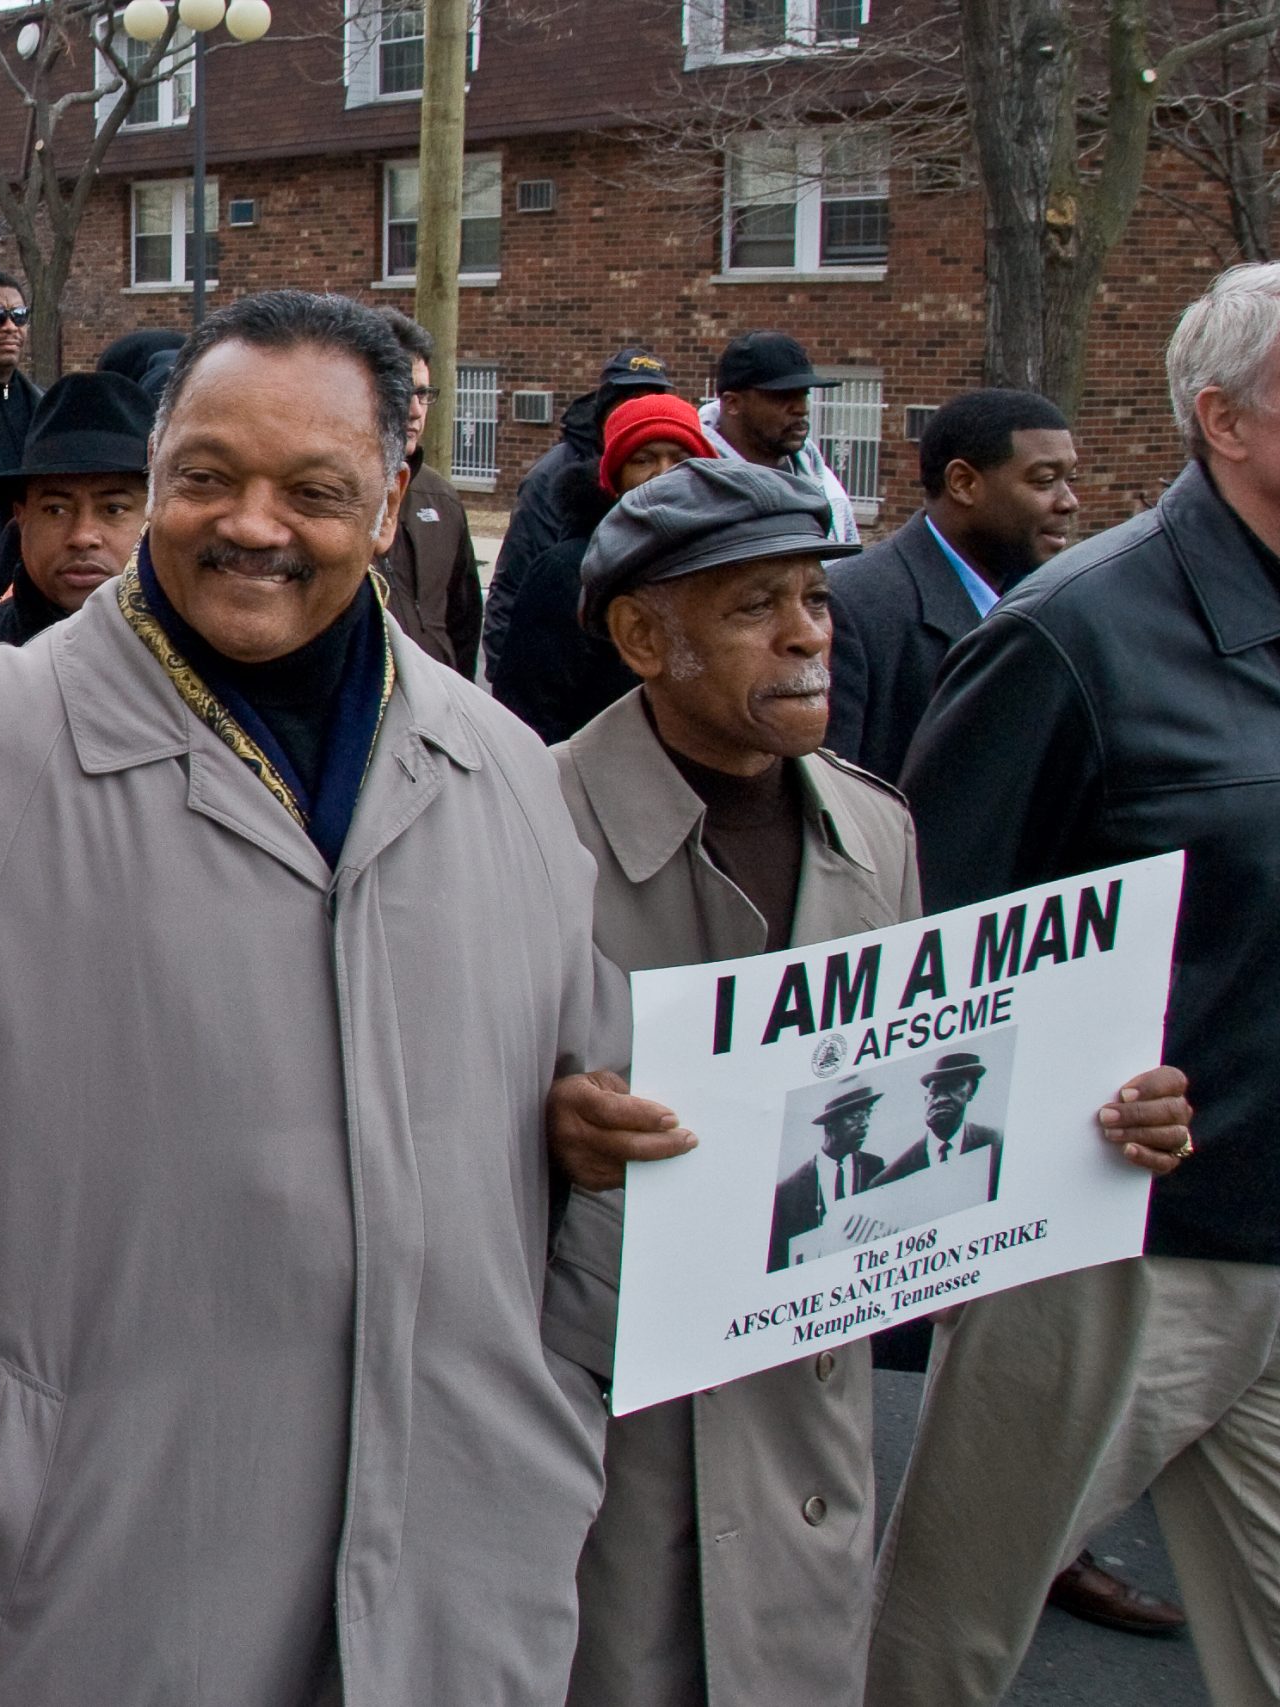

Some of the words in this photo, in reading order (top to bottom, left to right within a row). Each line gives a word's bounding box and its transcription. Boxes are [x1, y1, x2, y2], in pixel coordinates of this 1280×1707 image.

[712, 975, 737, 1056] I
[760, 943, 883, 1046] AM
[898, 928, 948, 1010] A
[970, 878, 1124, 989] MAN
[852, 987, 1015, 1066] AFSCME
[723, 1291, 824, 1341] AFSCME
[828, 1245, 964, 1308] SANITATION
[966, 1218, 1049, 1262] STRIKE
[852, 1249, 890, 1274] The
[895, 1227, 938, 1261] 1968
[791, 1299, 887, 1346] Memphis,
[890, 1269, 982, 1312] Tennessee
